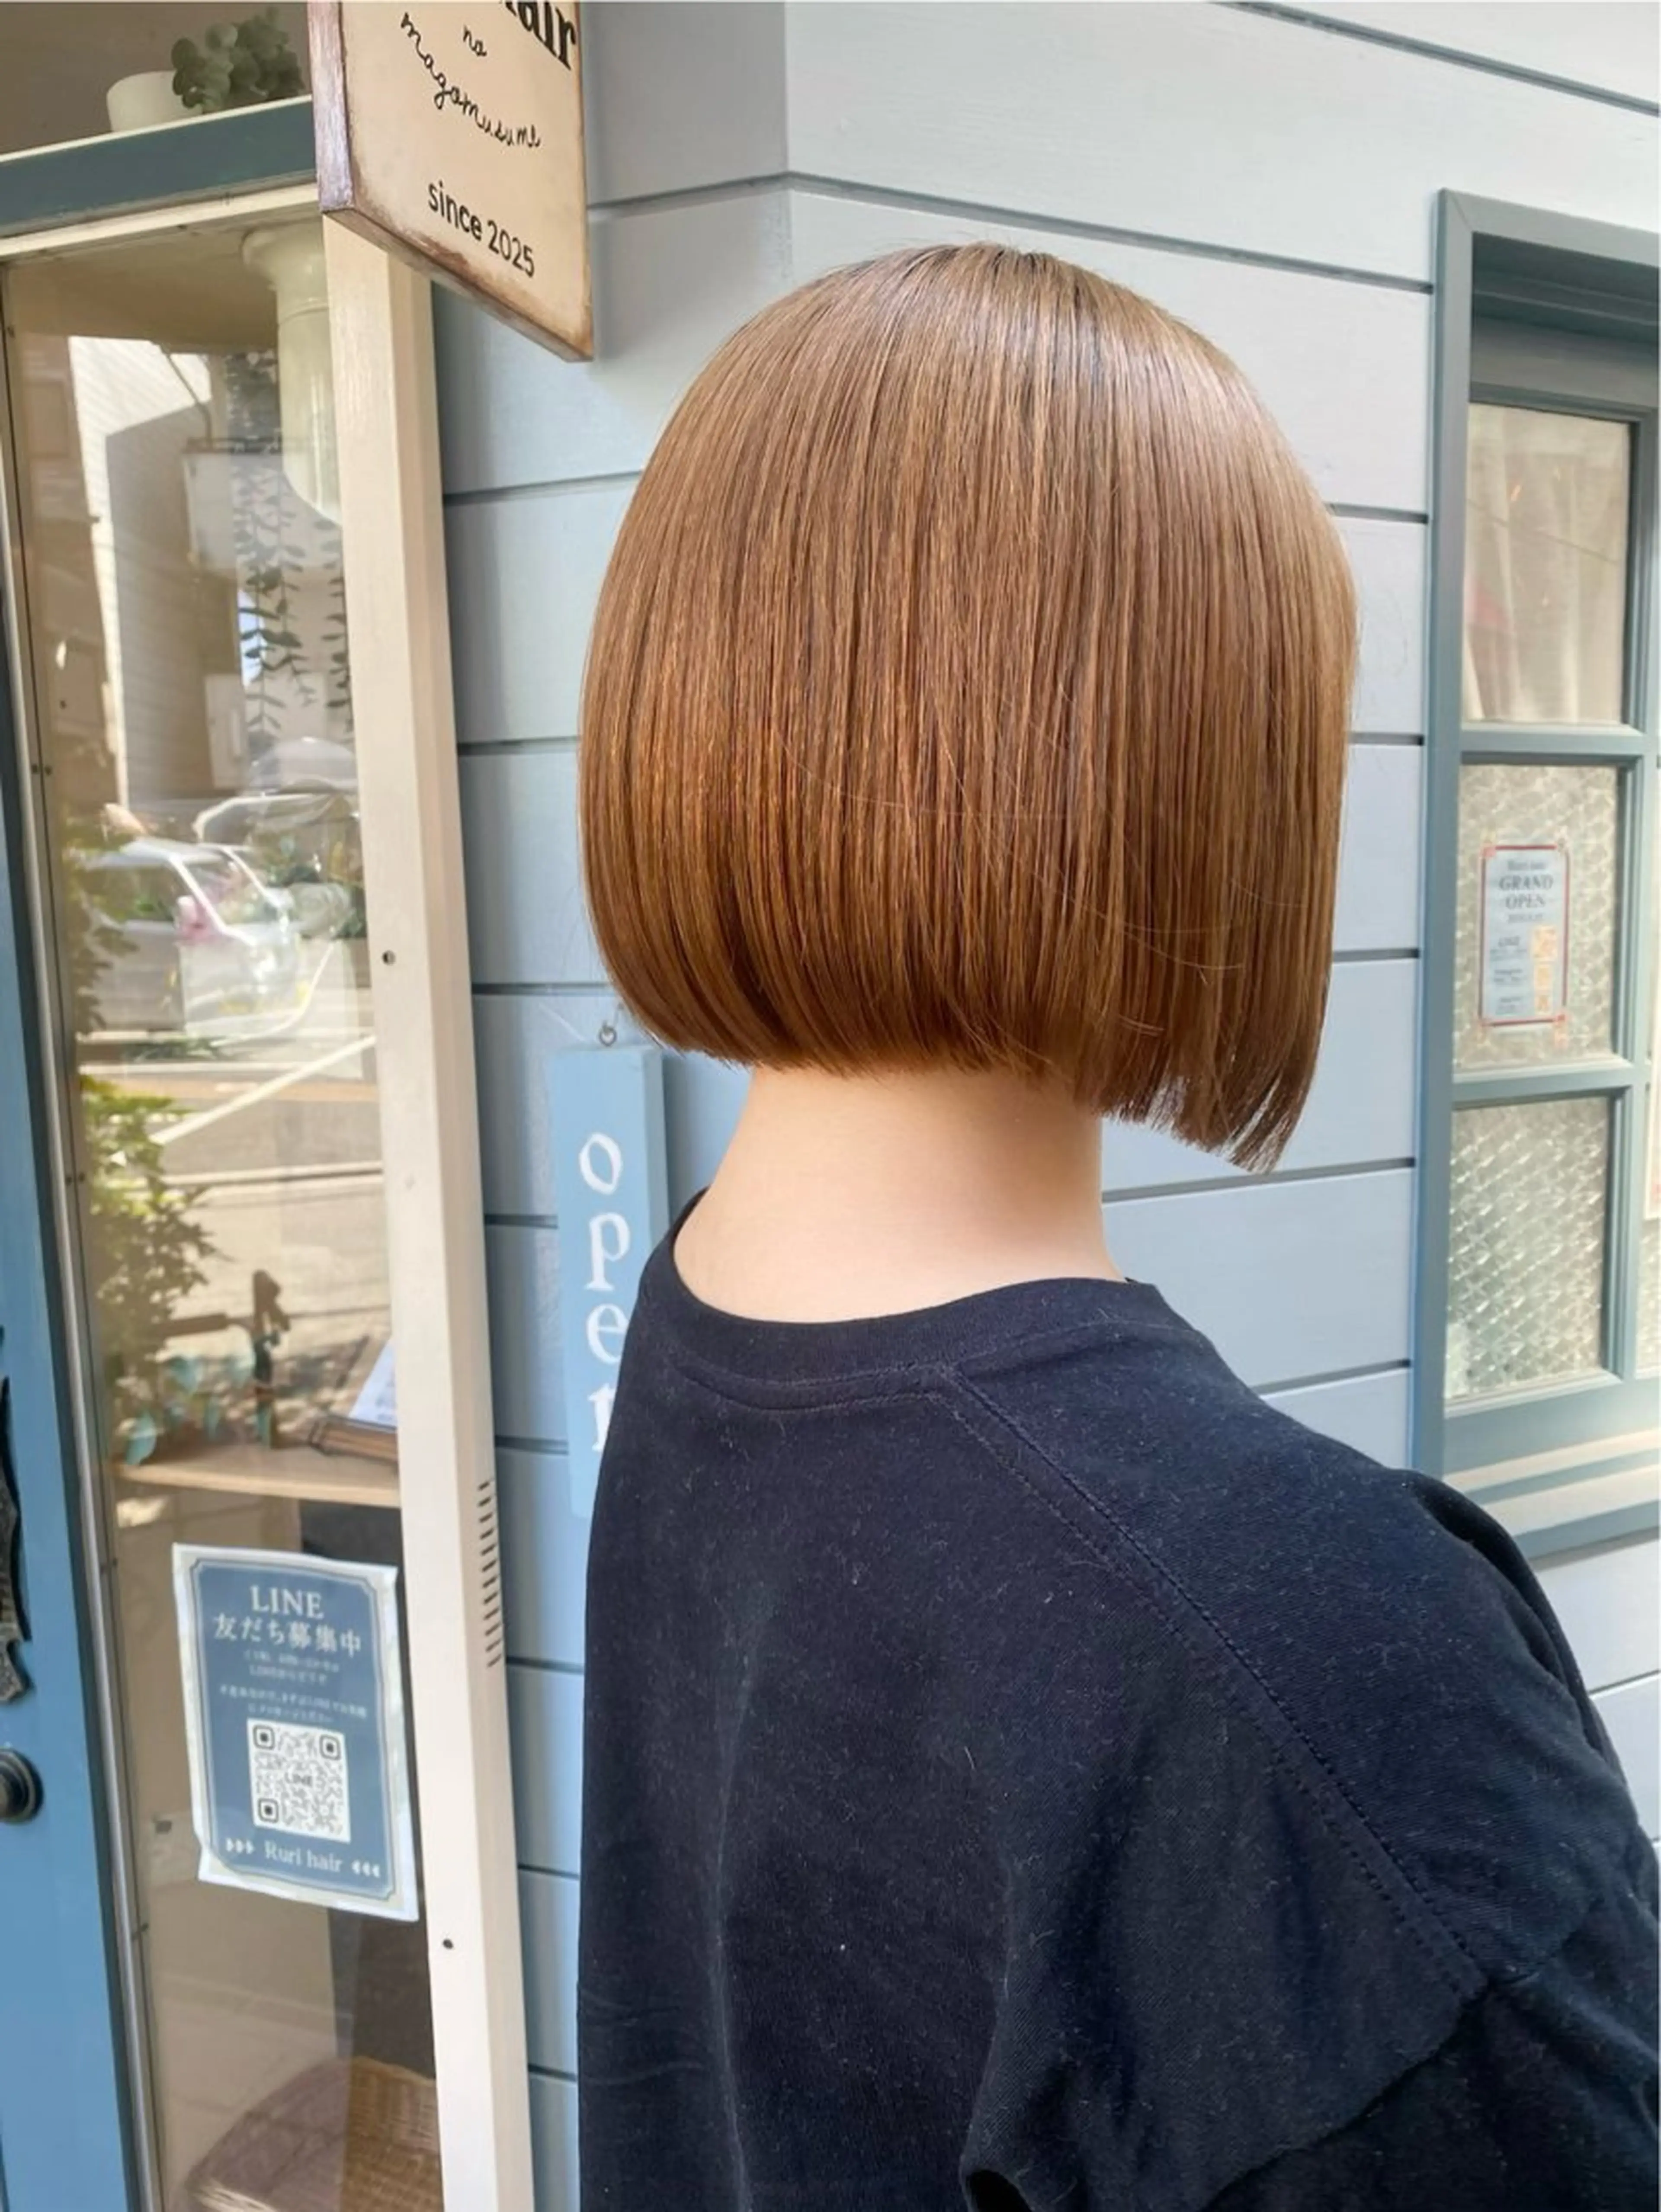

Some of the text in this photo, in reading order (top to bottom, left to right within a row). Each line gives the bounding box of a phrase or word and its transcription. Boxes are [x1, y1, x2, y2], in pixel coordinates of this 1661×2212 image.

[463, 25, 487, 56] no
[501, 2, 576, 71] air
[428, 179, 534, 278] since 2025
[1498, 875, 1554, 891] GRAND
[1506, 893, 1546, 909] OPEN
[250, 1585, 324, 1619] LINE
[213, 1612, 362, 1658] 友だち募集中
[307, 1849, 343, 1872] hair
